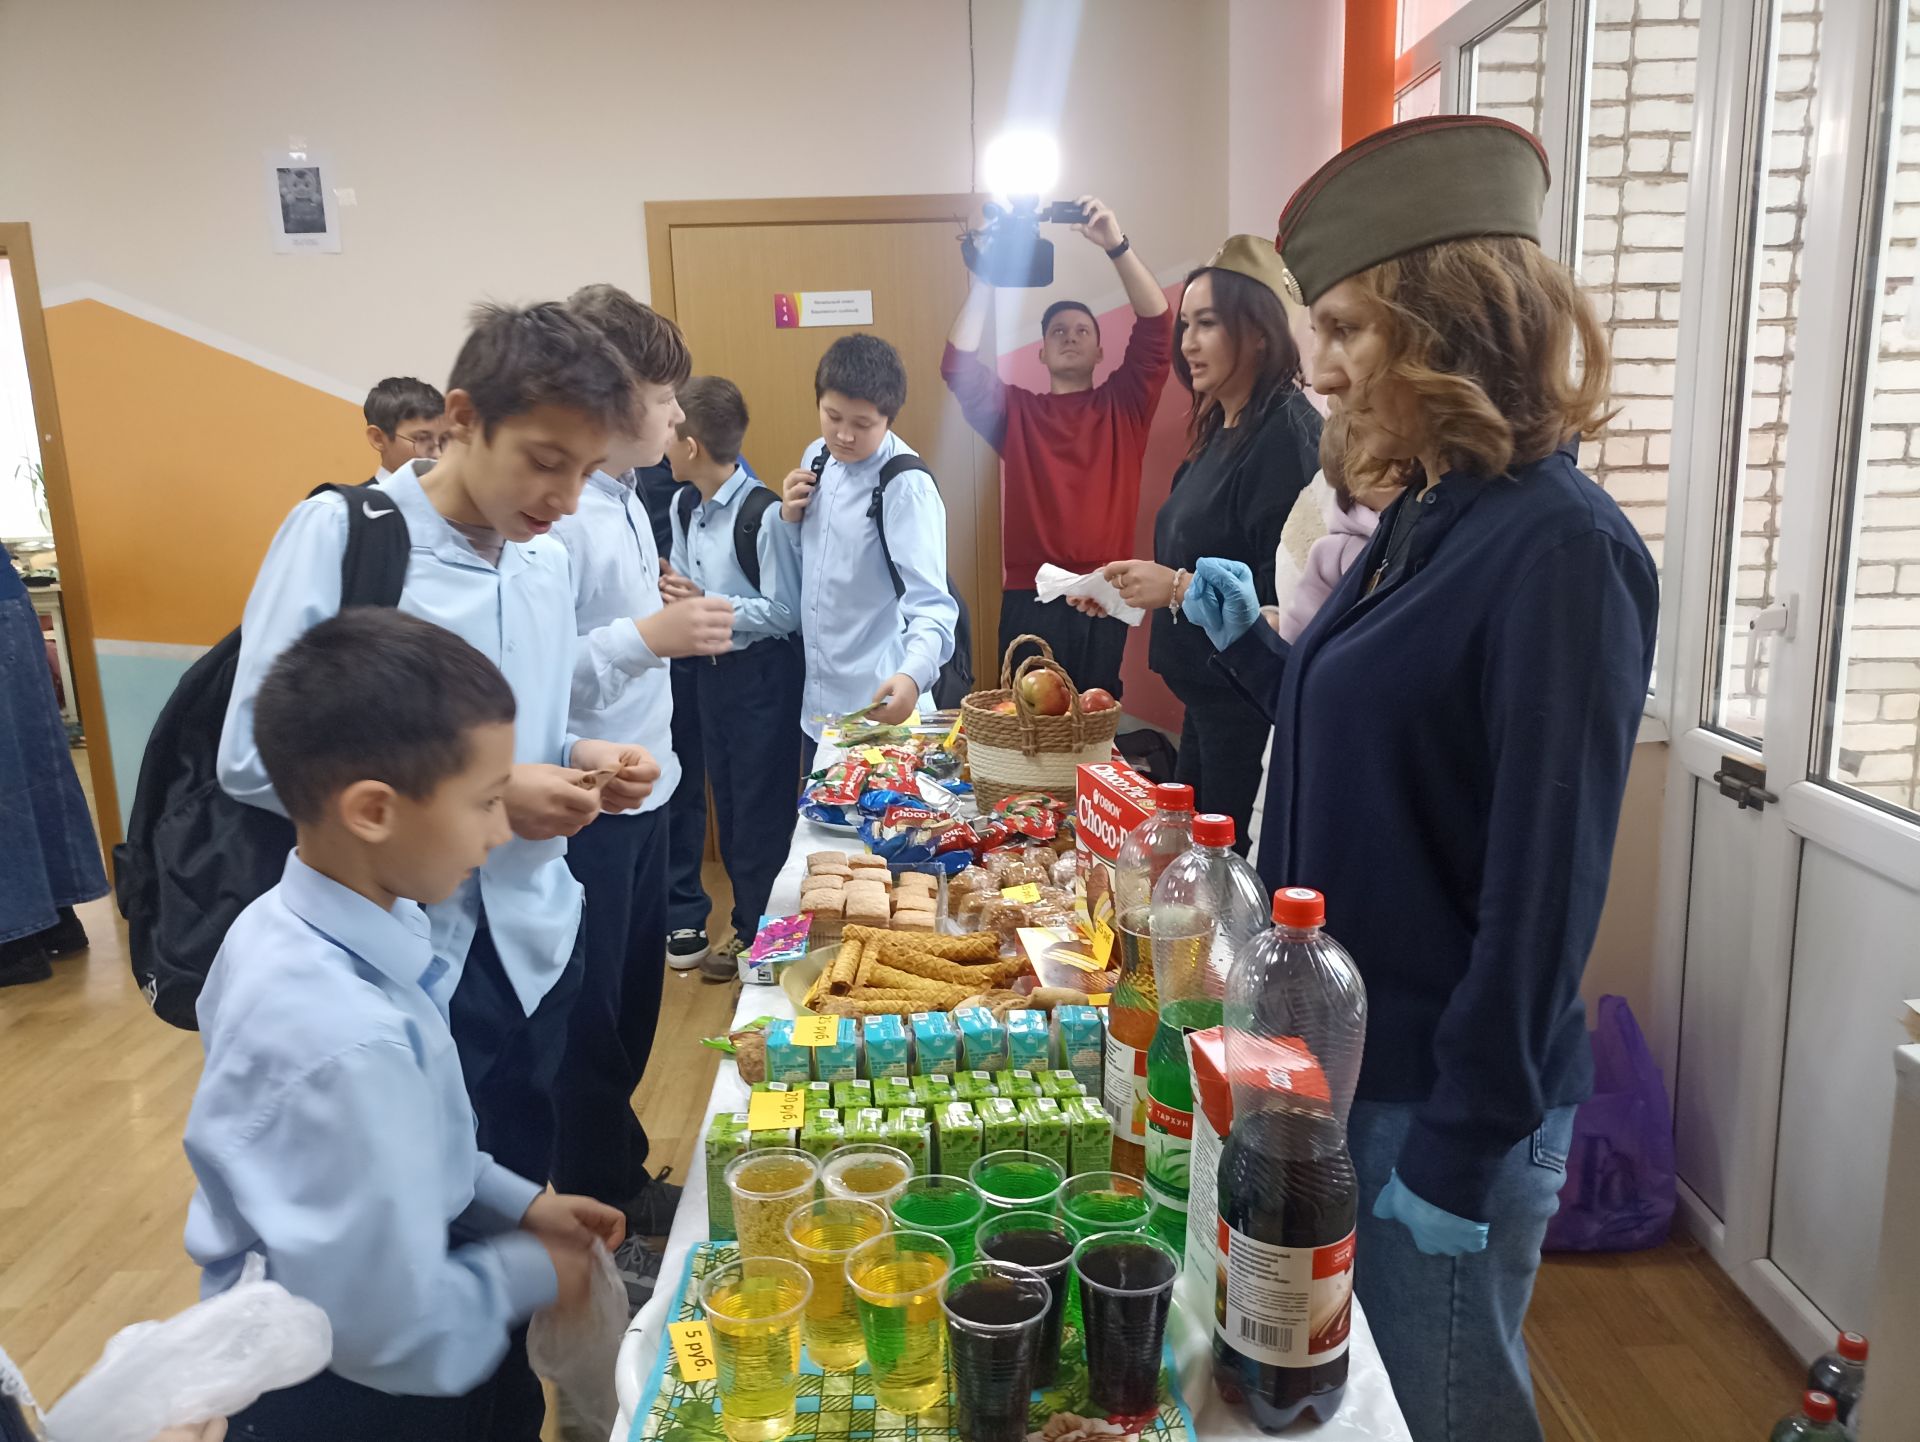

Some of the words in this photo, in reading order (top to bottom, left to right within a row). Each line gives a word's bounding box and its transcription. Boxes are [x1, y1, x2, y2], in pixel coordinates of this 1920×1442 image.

[818, 1016, 832, 1024] 25
[813, 1026, 830, 1042] руб.
[784, 1092, 799, 1103] 20
[780, 1104, 798, 1122] руб.
[1156, 1110, 1189, 1128] ТАРХУН
[685, 1330, 703, 1338] 5
[684, 1342, 713, 1372] руб.
